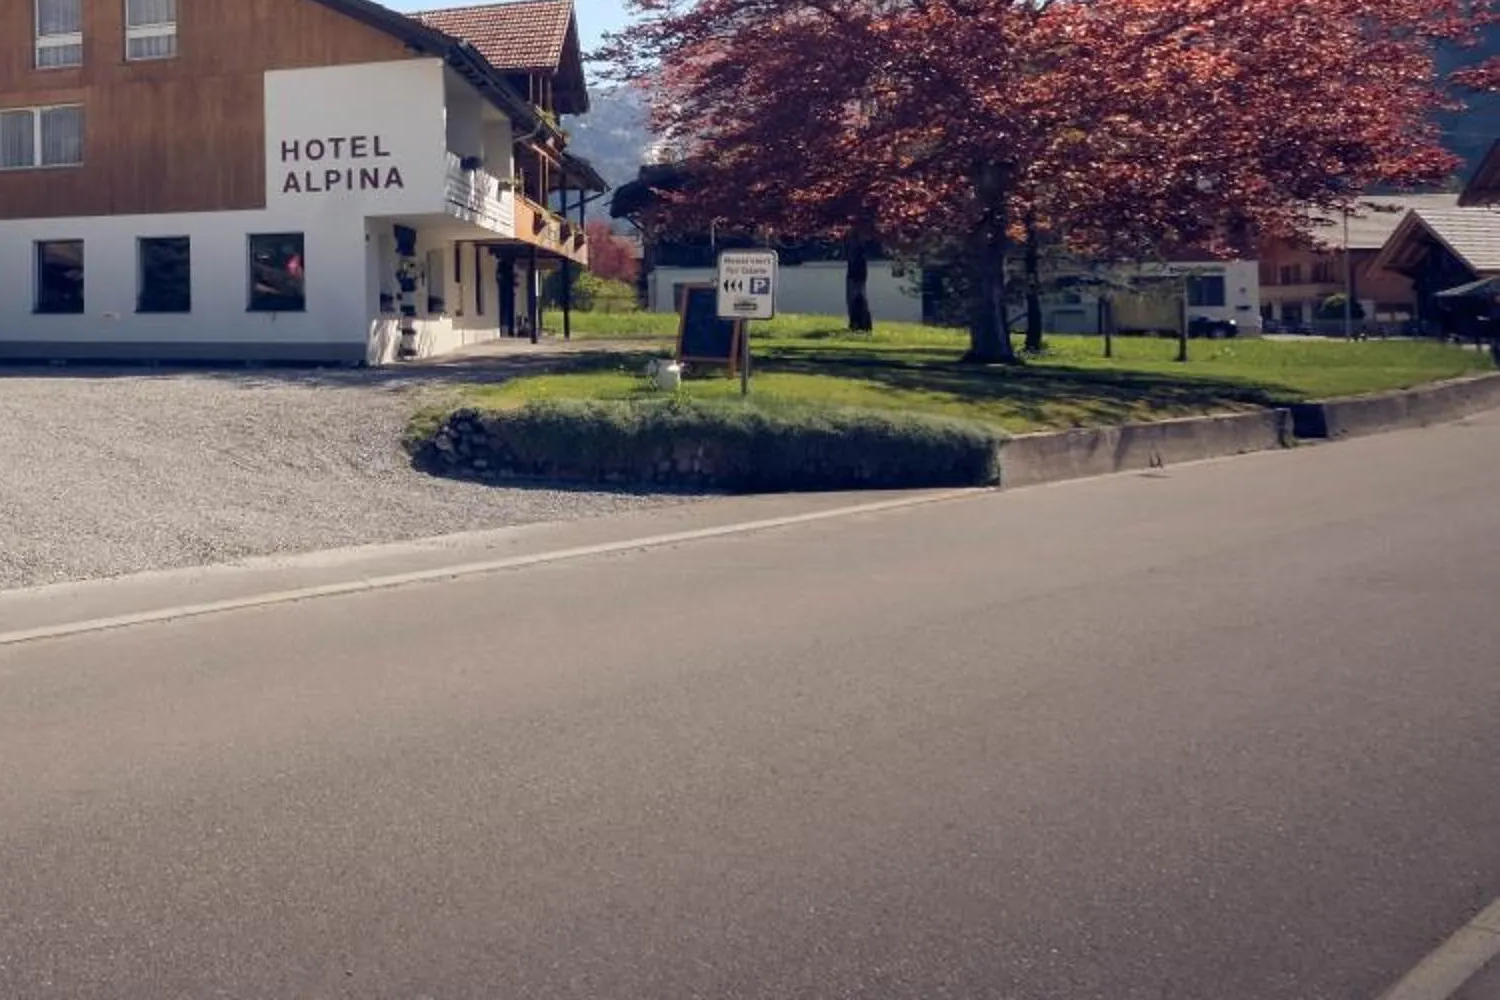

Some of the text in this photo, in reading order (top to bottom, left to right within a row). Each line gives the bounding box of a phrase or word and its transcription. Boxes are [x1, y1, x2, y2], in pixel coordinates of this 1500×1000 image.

[281, 135, 391, 162] HOTEL
[282, 166, 405, 193] ALPINA
[753, 279, 766, 293] P
